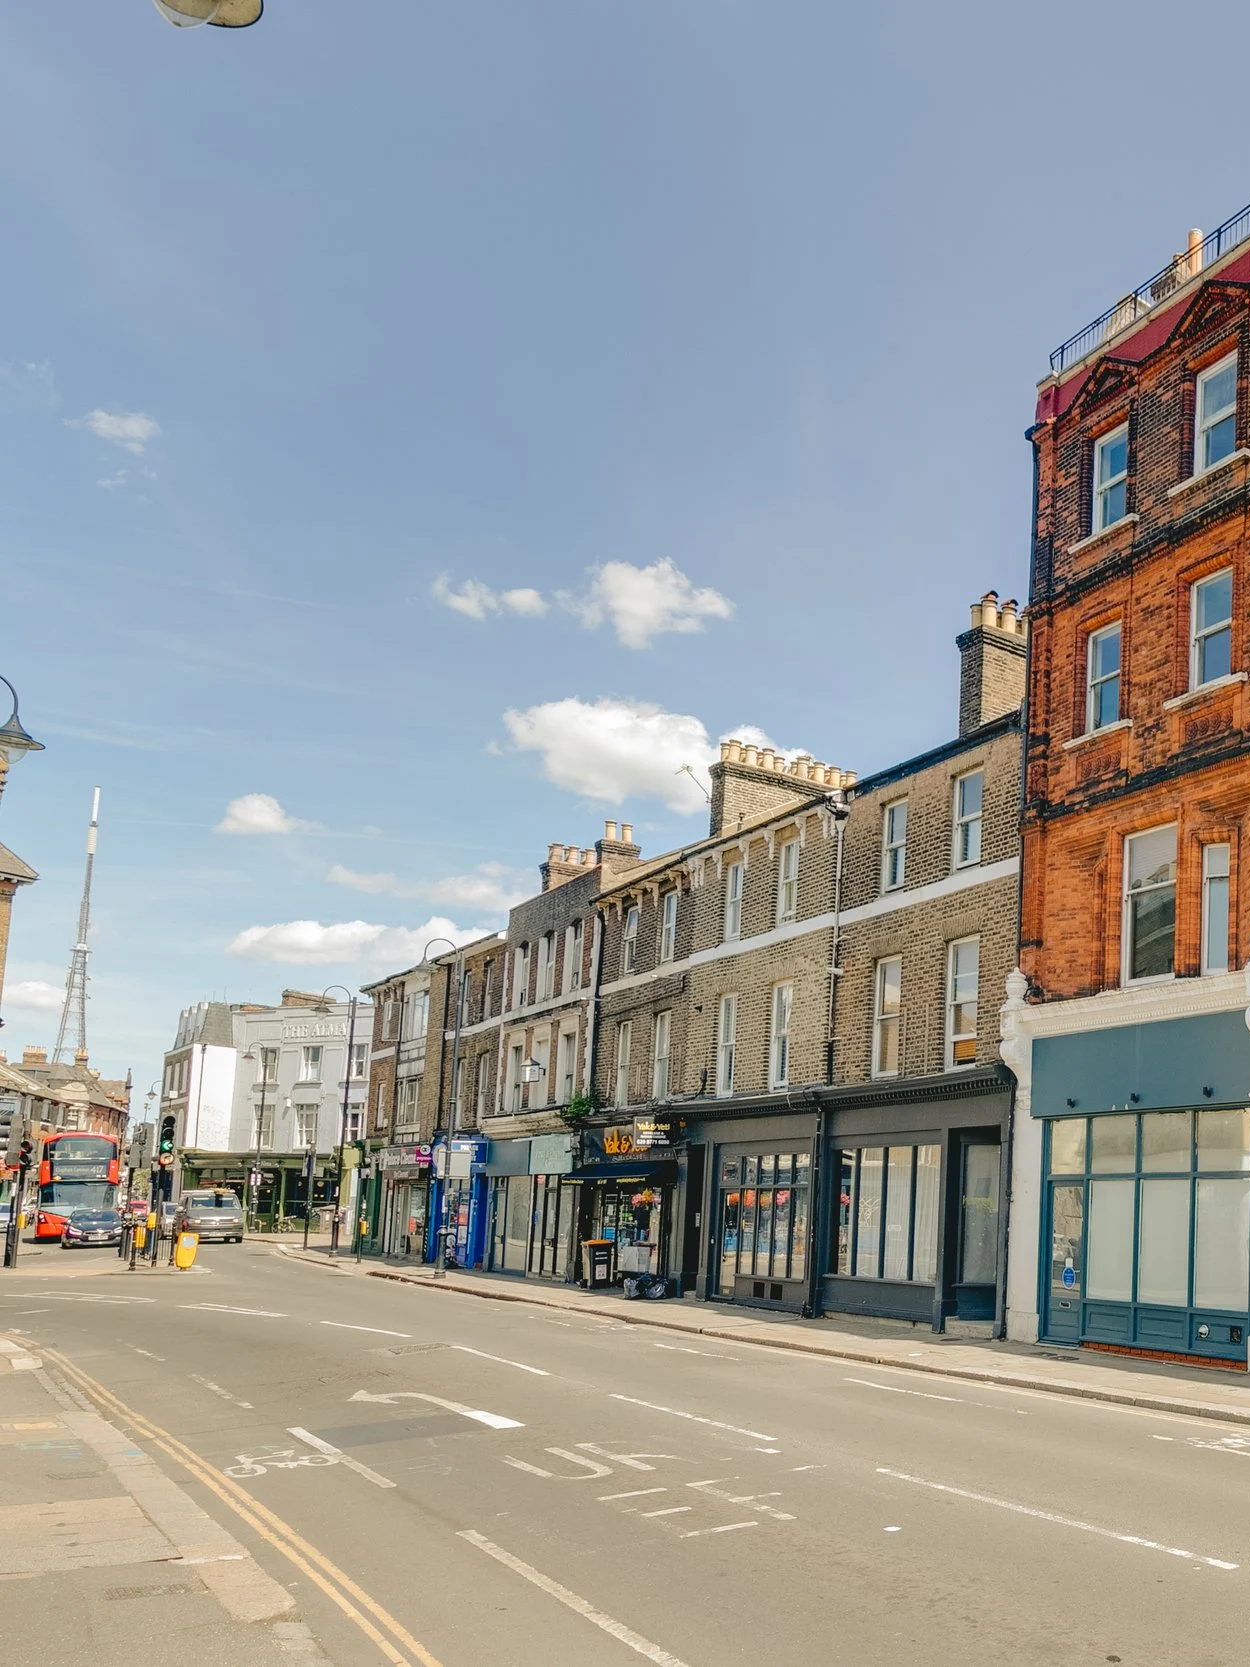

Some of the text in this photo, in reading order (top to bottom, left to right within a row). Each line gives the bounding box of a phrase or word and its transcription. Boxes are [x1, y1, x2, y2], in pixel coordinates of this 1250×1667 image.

[283, 1022, 347, 1037] THE ALMA
[637, 1121, 650, 1131] Yak
[603, 1128, 630, 1154] Yak &
[90, 1165, 105, 1174] 417
